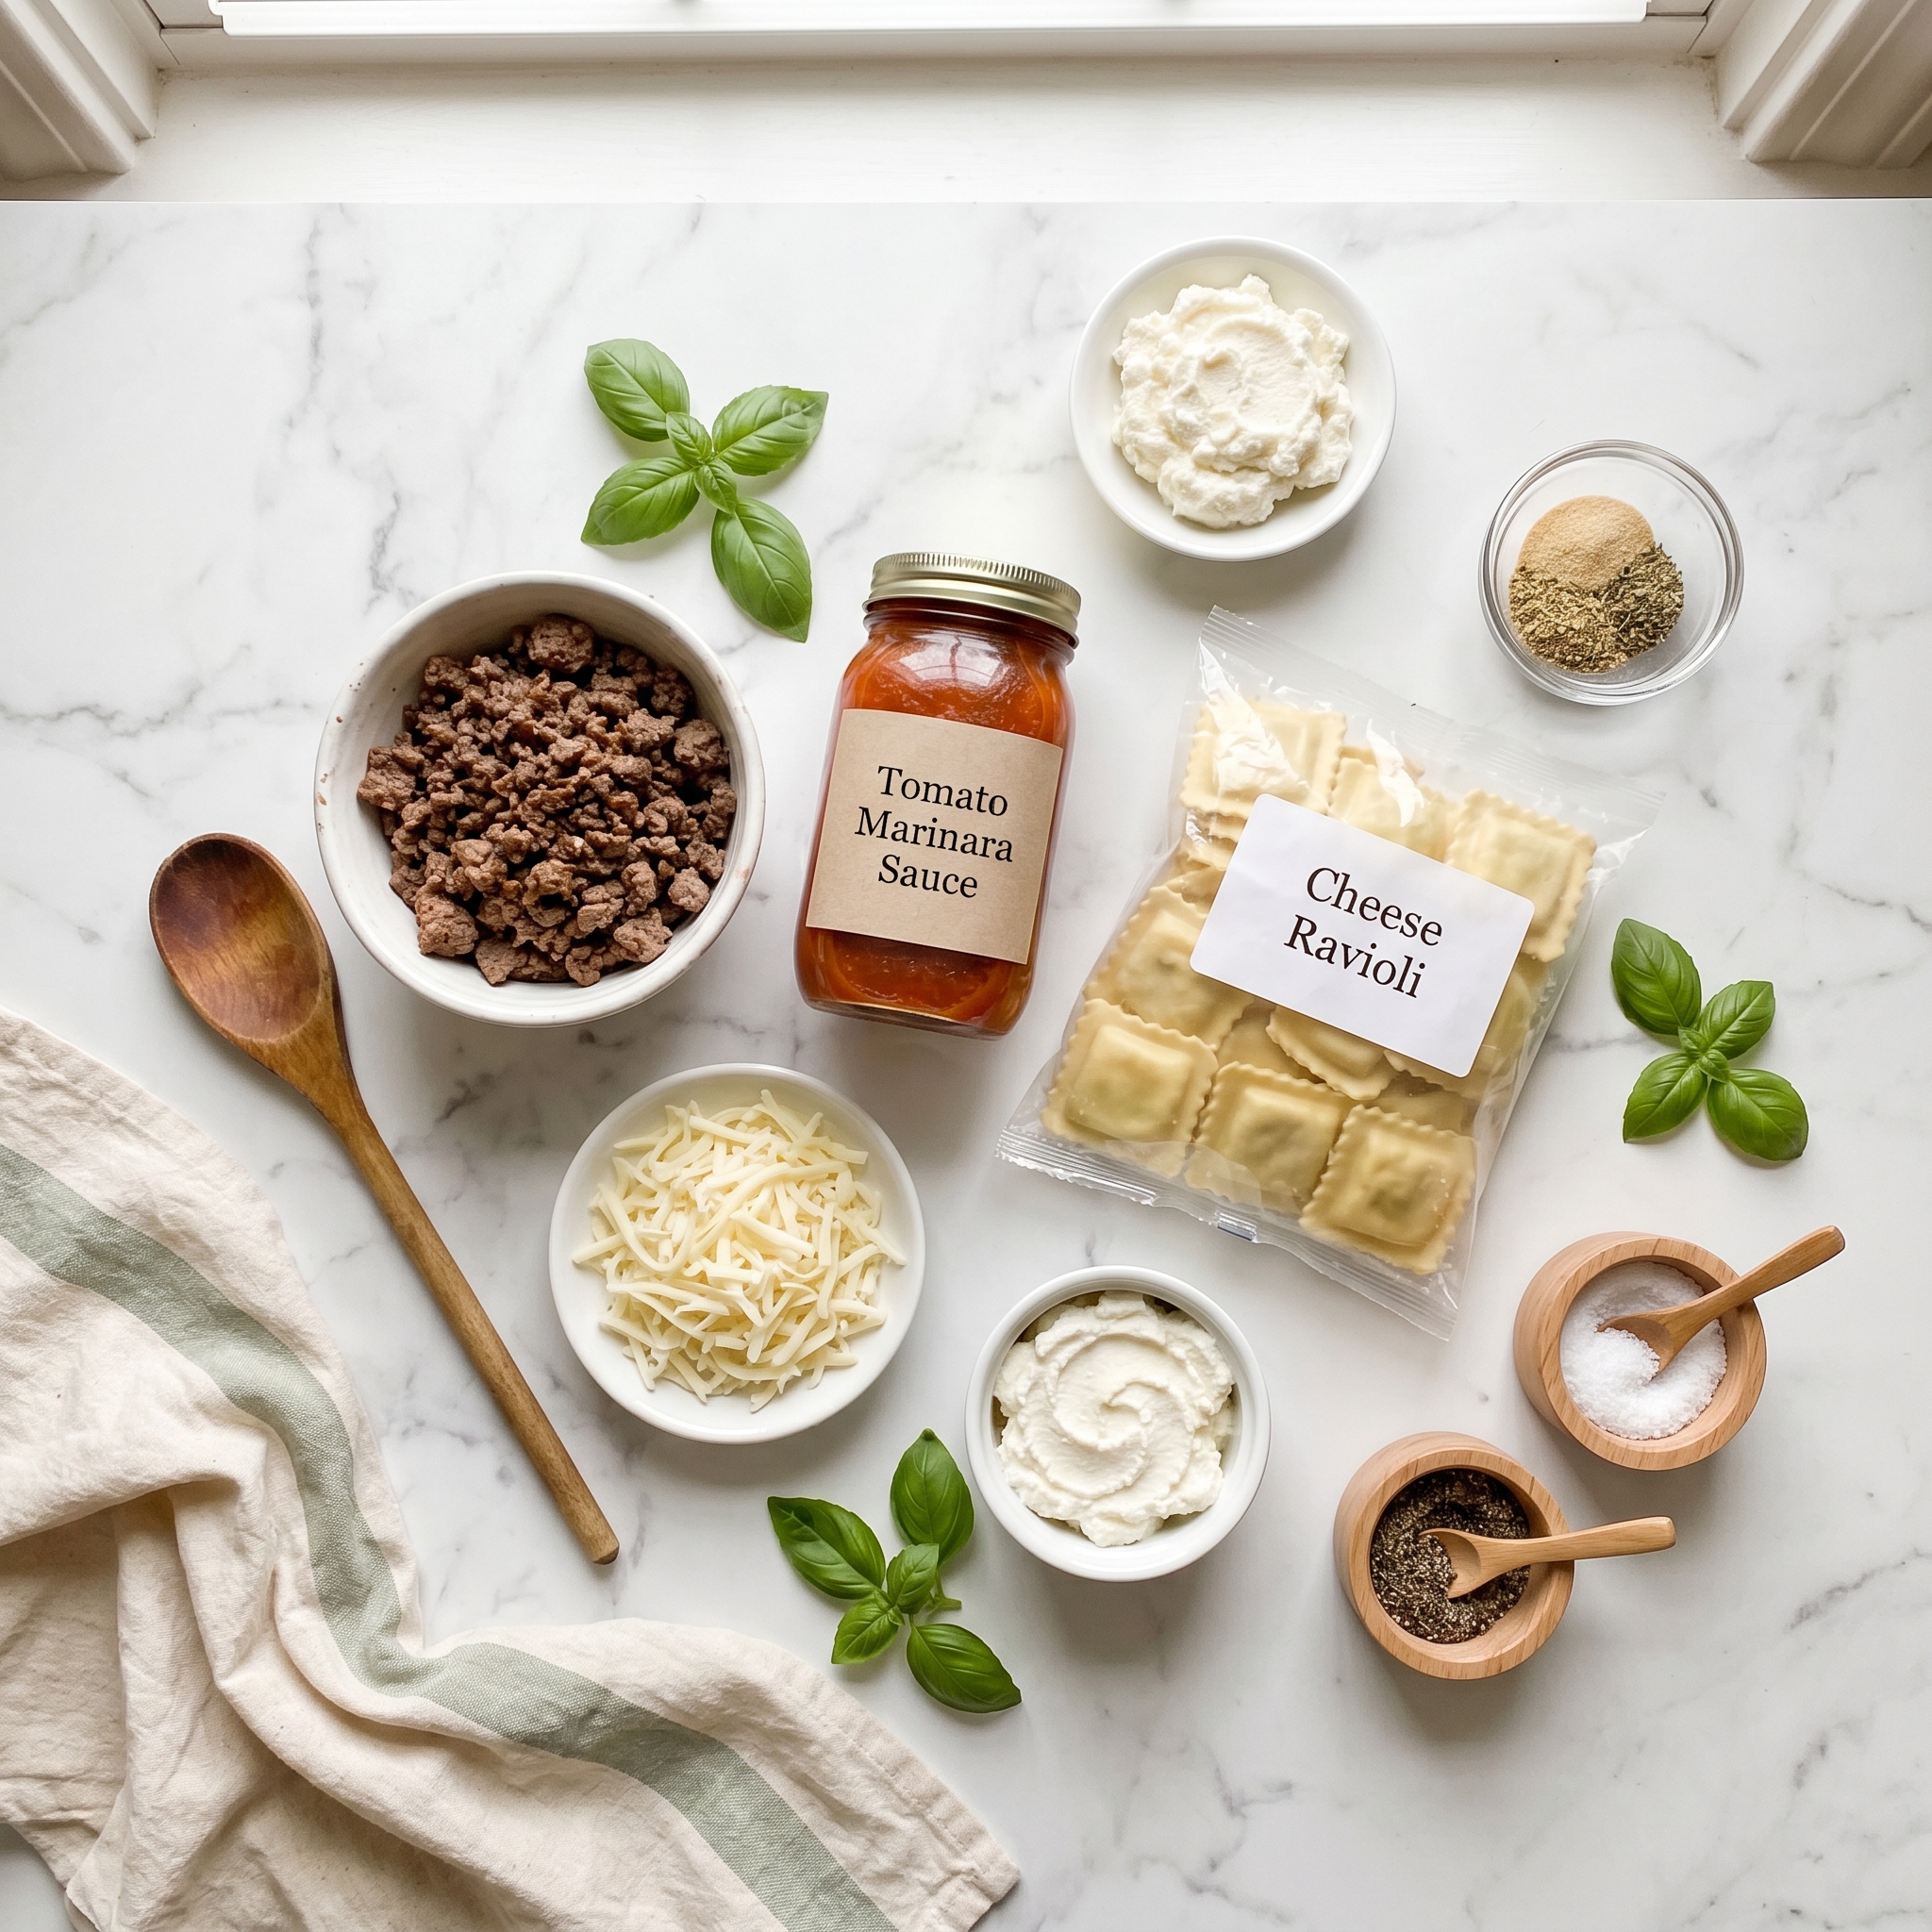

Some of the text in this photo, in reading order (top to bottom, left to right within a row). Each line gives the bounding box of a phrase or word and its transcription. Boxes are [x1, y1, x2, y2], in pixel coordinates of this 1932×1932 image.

[877, 765, 1008, 817] Tomato
[855, 806, 1014, 864] Marinara
[877, 854, 978, 899] Sauce
[1307, 867, 1442, 946] Cheese
[1283, 914, 1425, 999] Ravioli
